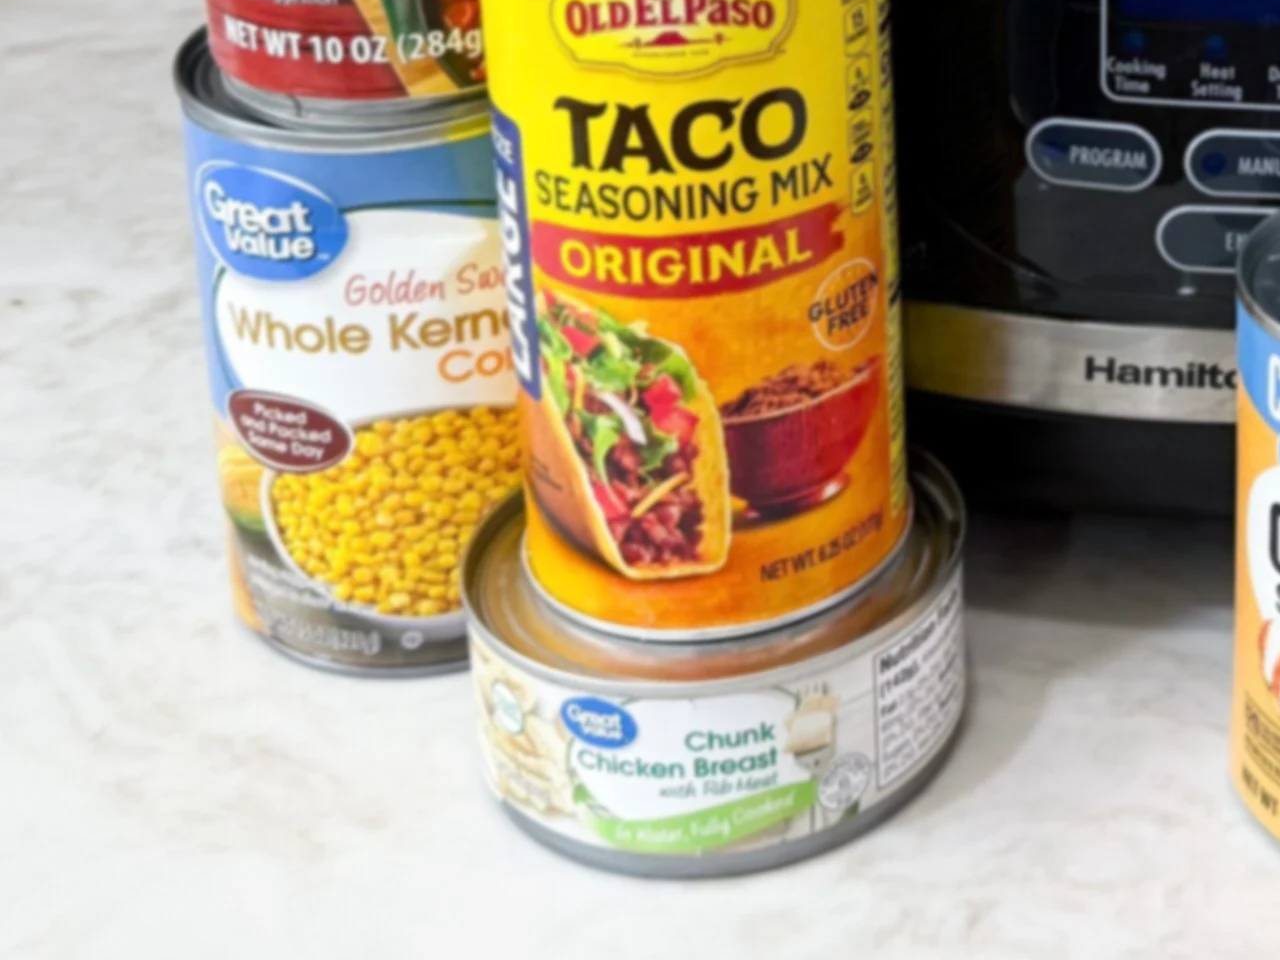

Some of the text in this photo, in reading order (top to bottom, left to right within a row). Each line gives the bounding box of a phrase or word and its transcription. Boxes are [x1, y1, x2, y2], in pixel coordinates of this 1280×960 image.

[223, 14, 484, 65] NET WT 10 OZ (284g
[1107, 56, 1168, 80] Cooking
[1114, 76, 1150, 94] Time
[1200, 62, 1236, 80] Heat
[1190, 80, 1244, 103] Setting
[552, 86, 808, 175] TACO
[1069, 145, 1149, 171] PROGRAM
[534, 153, 835, 222] SEASONING MIX
[204, 181, 313, 234] Great
[224, 224, 315, 261] Value
[559, 228, 813, 286] ORIGINAL
[343, 269, 446, 307] Golden
[807, 268, 879, 323] GLUTEN
[227, 299, 511, 354] Whole Kern
[827, 299, 868, 337] FREE
[1084, 355, 1238, 390] Hamilto
[290, 440, 326, 461] Day
[565, 700, 622, 730] Great
[683, 721, 776, 753] Chunk
[577, 746, 779, 779] Chicken Breast
[1260, 787, 1279, 817] WT
